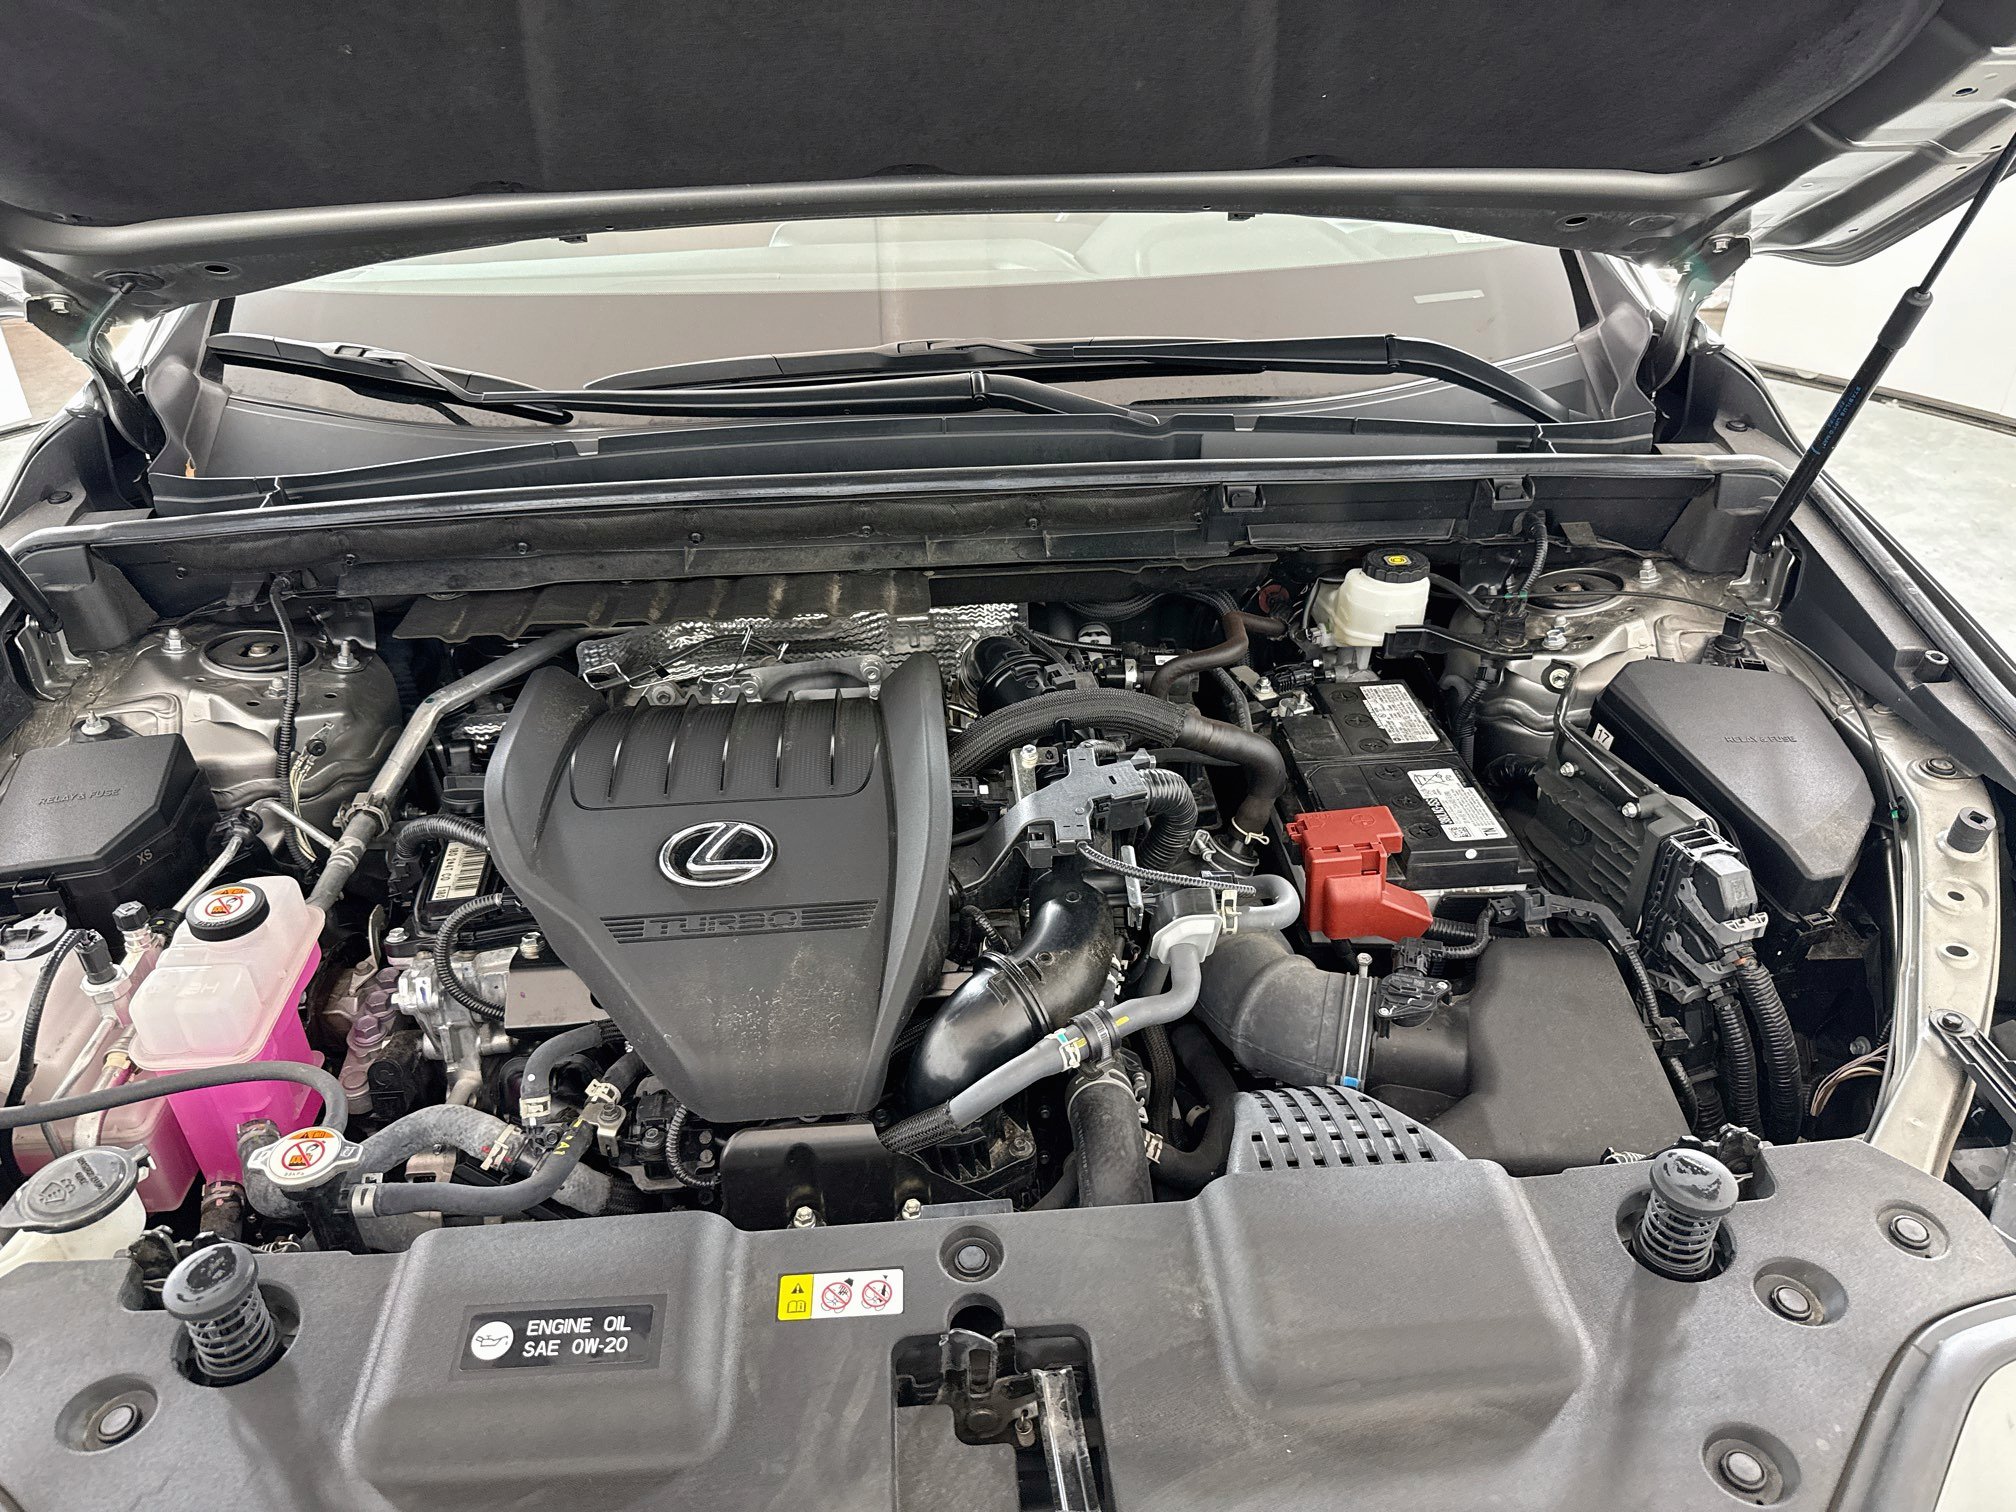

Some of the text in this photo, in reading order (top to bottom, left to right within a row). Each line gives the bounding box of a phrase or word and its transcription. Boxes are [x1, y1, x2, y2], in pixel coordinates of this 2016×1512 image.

[1598, 728, 1610, 743] 17
[137, 849, 153, 865] XS
[649, 910, 798, 936] TURBO
[526, 1315, 631, 1335] ENGINE OIL
[522, 1336, 629, 1357] SAE 0W-20
